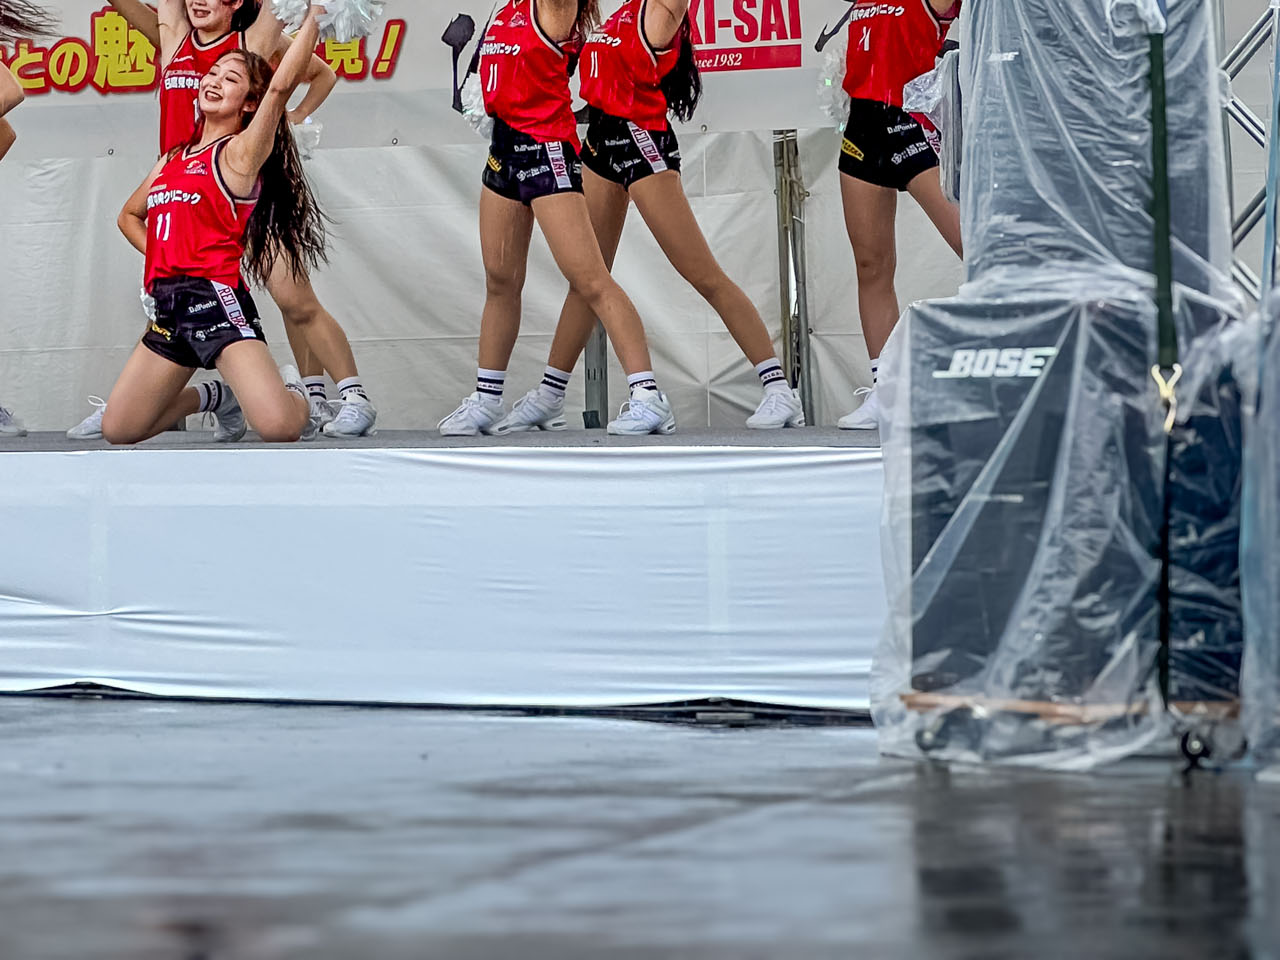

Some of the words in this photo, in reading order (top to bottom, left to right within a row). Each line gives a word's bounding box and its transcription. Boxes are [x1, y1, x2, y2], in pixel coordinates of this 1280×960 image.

[486, 63, 498, 92] 11
[589, 50, 599, 79] 11
[157, 212, 172, 241] 11
[932, 346, 1057, 379] BOSE
